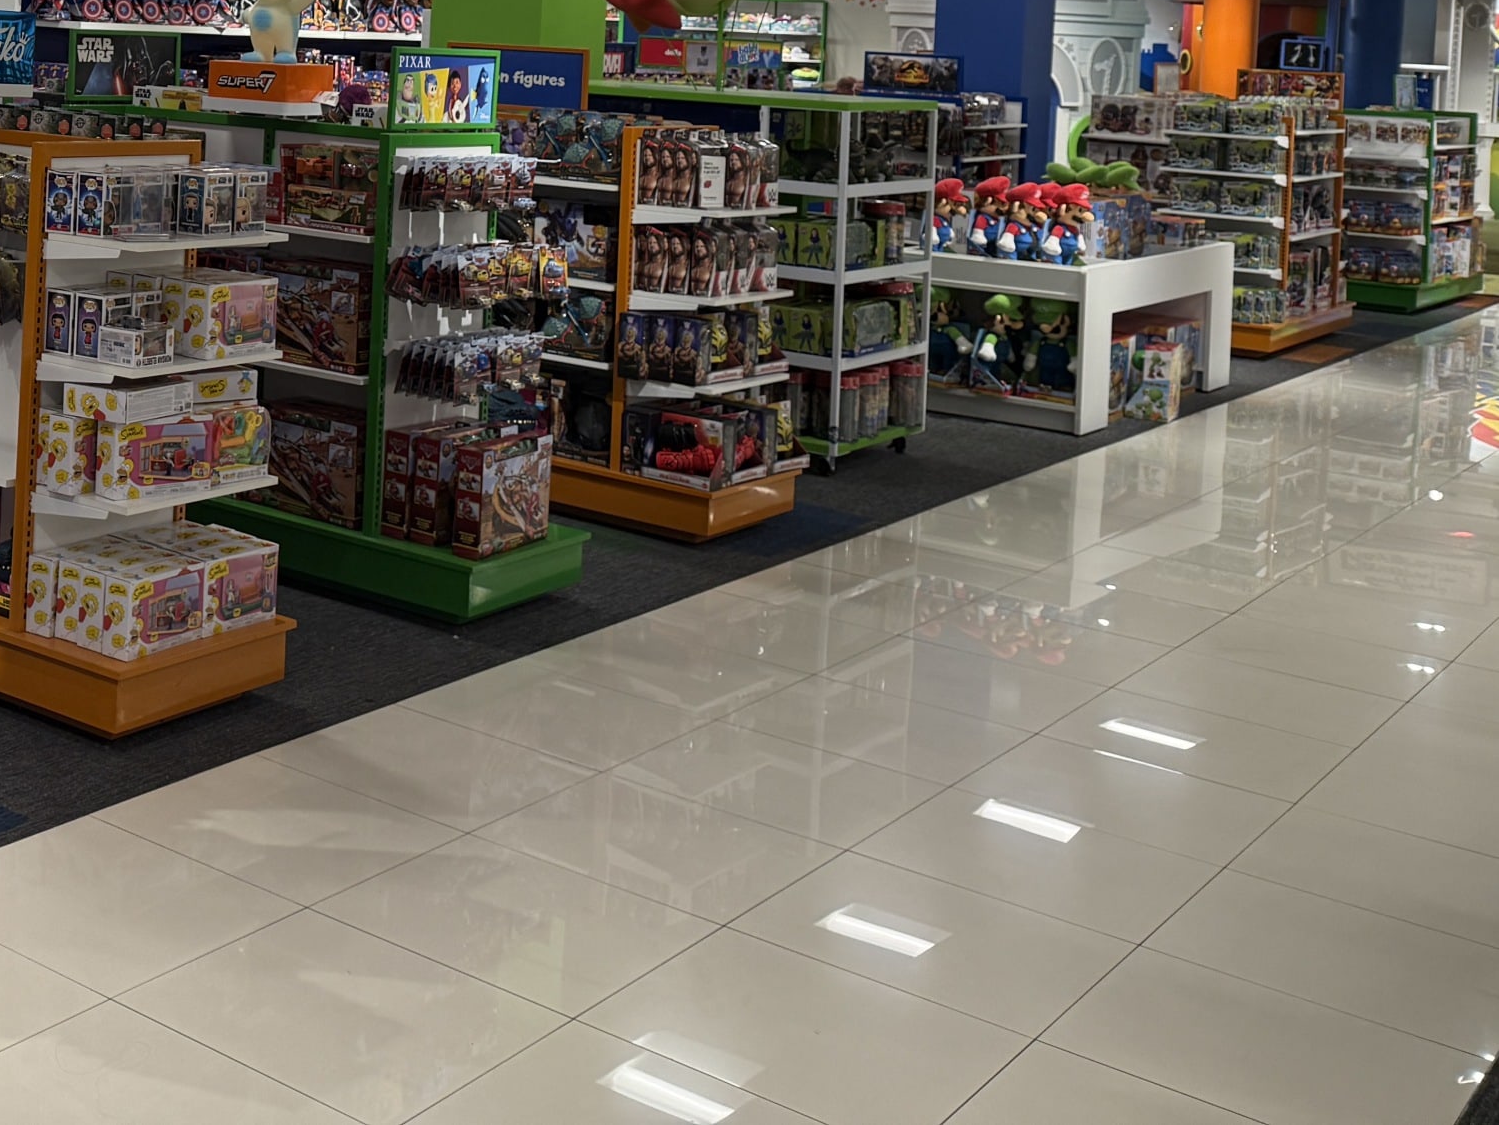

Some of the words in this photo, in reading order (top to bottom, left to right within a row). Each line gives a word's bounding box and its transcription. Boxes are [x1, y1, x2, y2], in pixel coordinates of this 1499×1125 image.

[78, 37, 115, 50] STAR
[77, 48, 115, 63] WARS
[399, 55, 432, 69] PIXAR
[513, 70, 566, 90] figures
